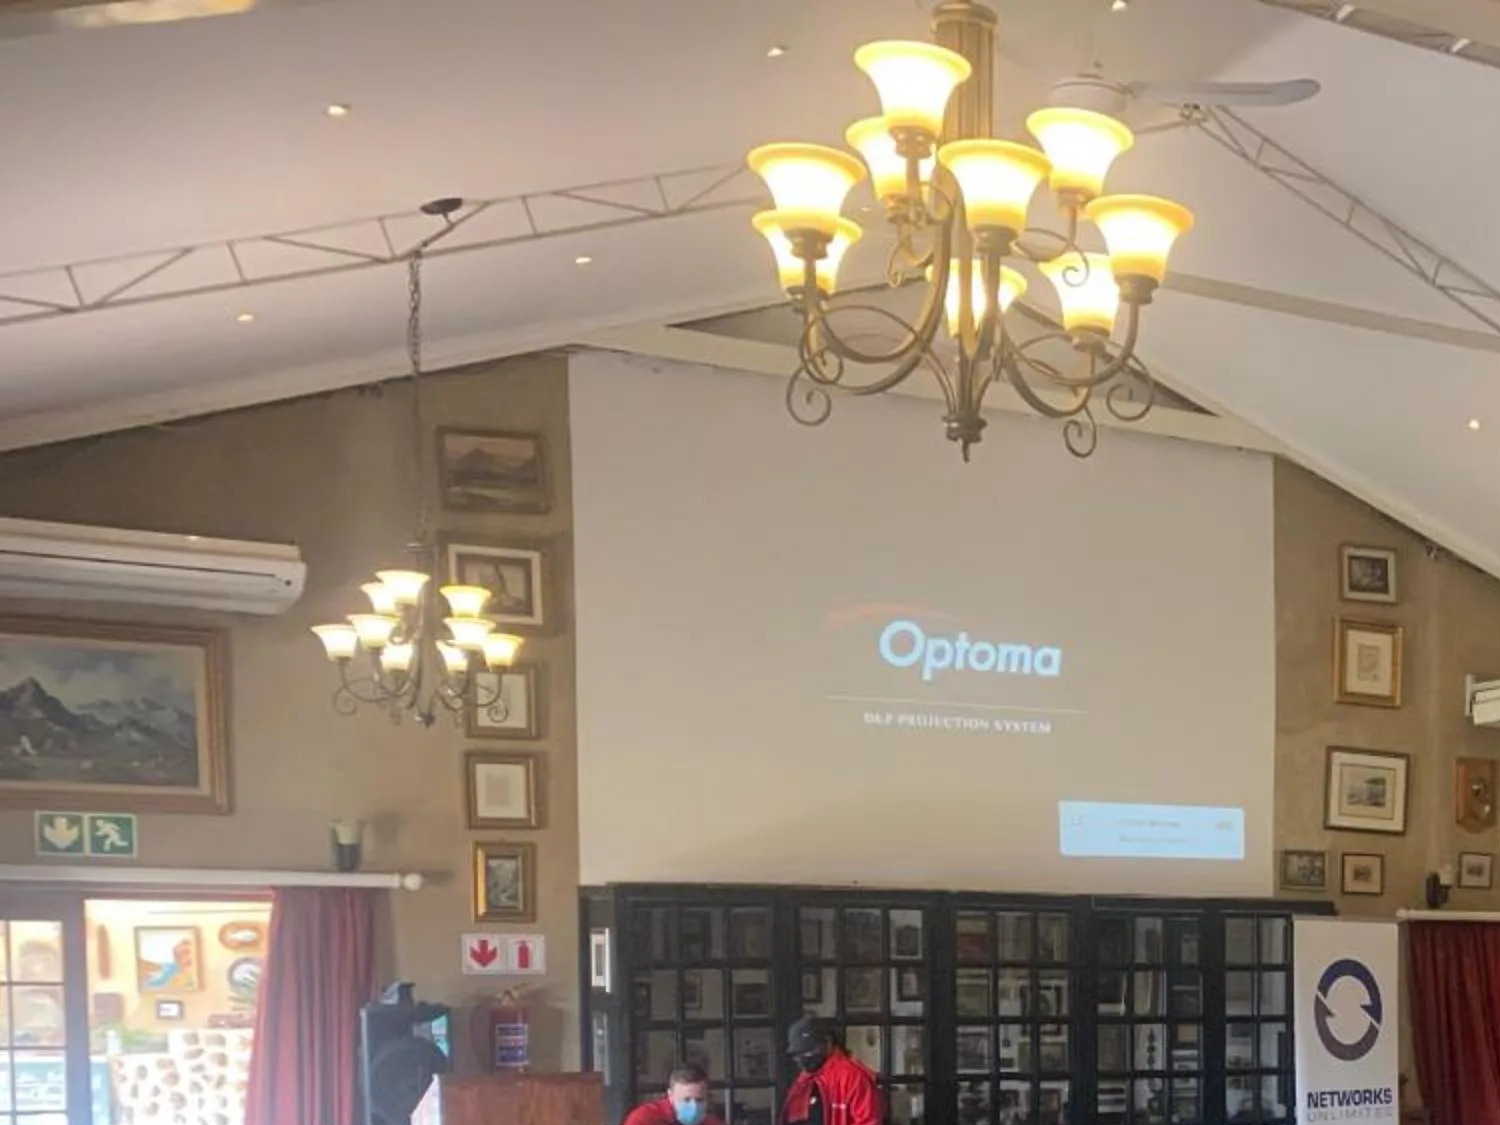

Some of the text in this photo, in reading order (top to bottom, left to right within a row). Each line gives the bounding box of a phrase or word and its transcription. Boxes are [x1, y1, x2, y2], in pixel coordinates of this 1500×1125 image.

[879, 619, 1062, 682] Optoma
[897, 713, 990, 731] PROJECTION
[992, 718, 1053, 734] SYSTEM
[1306, 1087, 1393, 1109] NETWORKS
